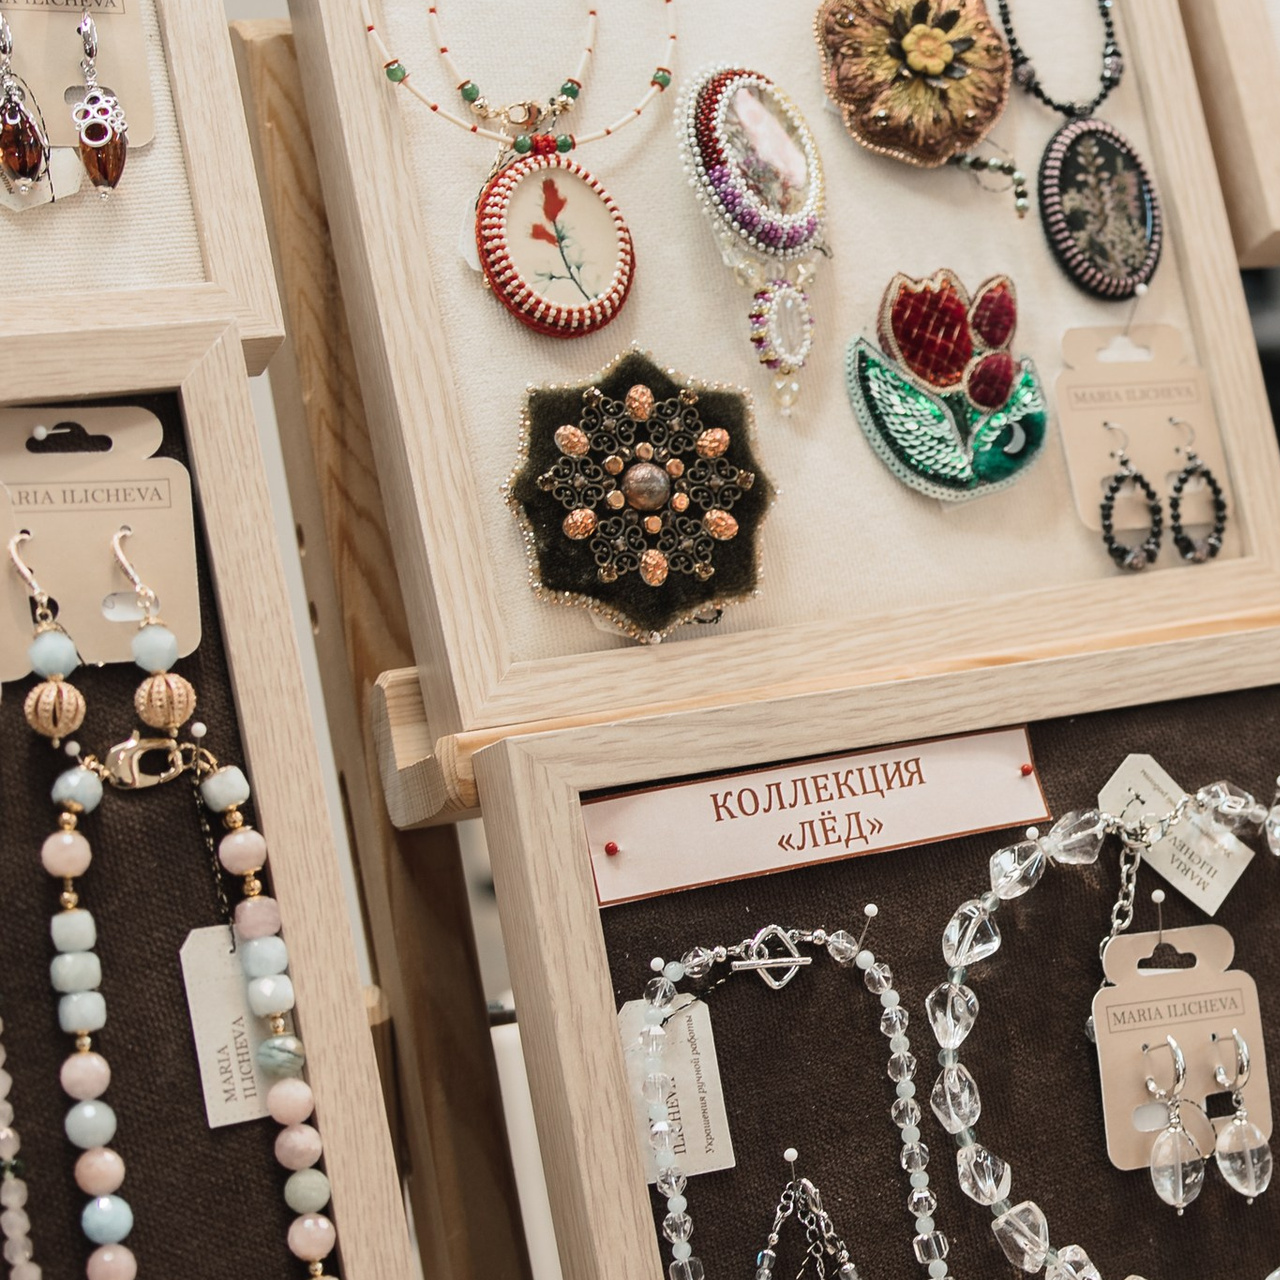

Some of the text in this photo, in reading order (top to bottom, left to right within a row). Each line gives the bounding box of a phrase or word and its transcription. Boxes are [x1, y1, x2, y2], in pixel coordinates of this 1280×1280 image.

[12, 486, 163, 506] RIA ILICHEVA
[709, 756, 927, 823] КОЛЛЕКЦИЯ
[777, 810, 884, 852] «ЛЁД»
[1170, 853, 1210, 892] MARIA
[1112, 996, 1239, 1026] MARIA ILICHEVA
[217, 1044, 238, 1104] MARIA
[232, 1015, 257, 1100] ILICHEVA
[686, 1015, 715, 1154] Украшения ручной работы
